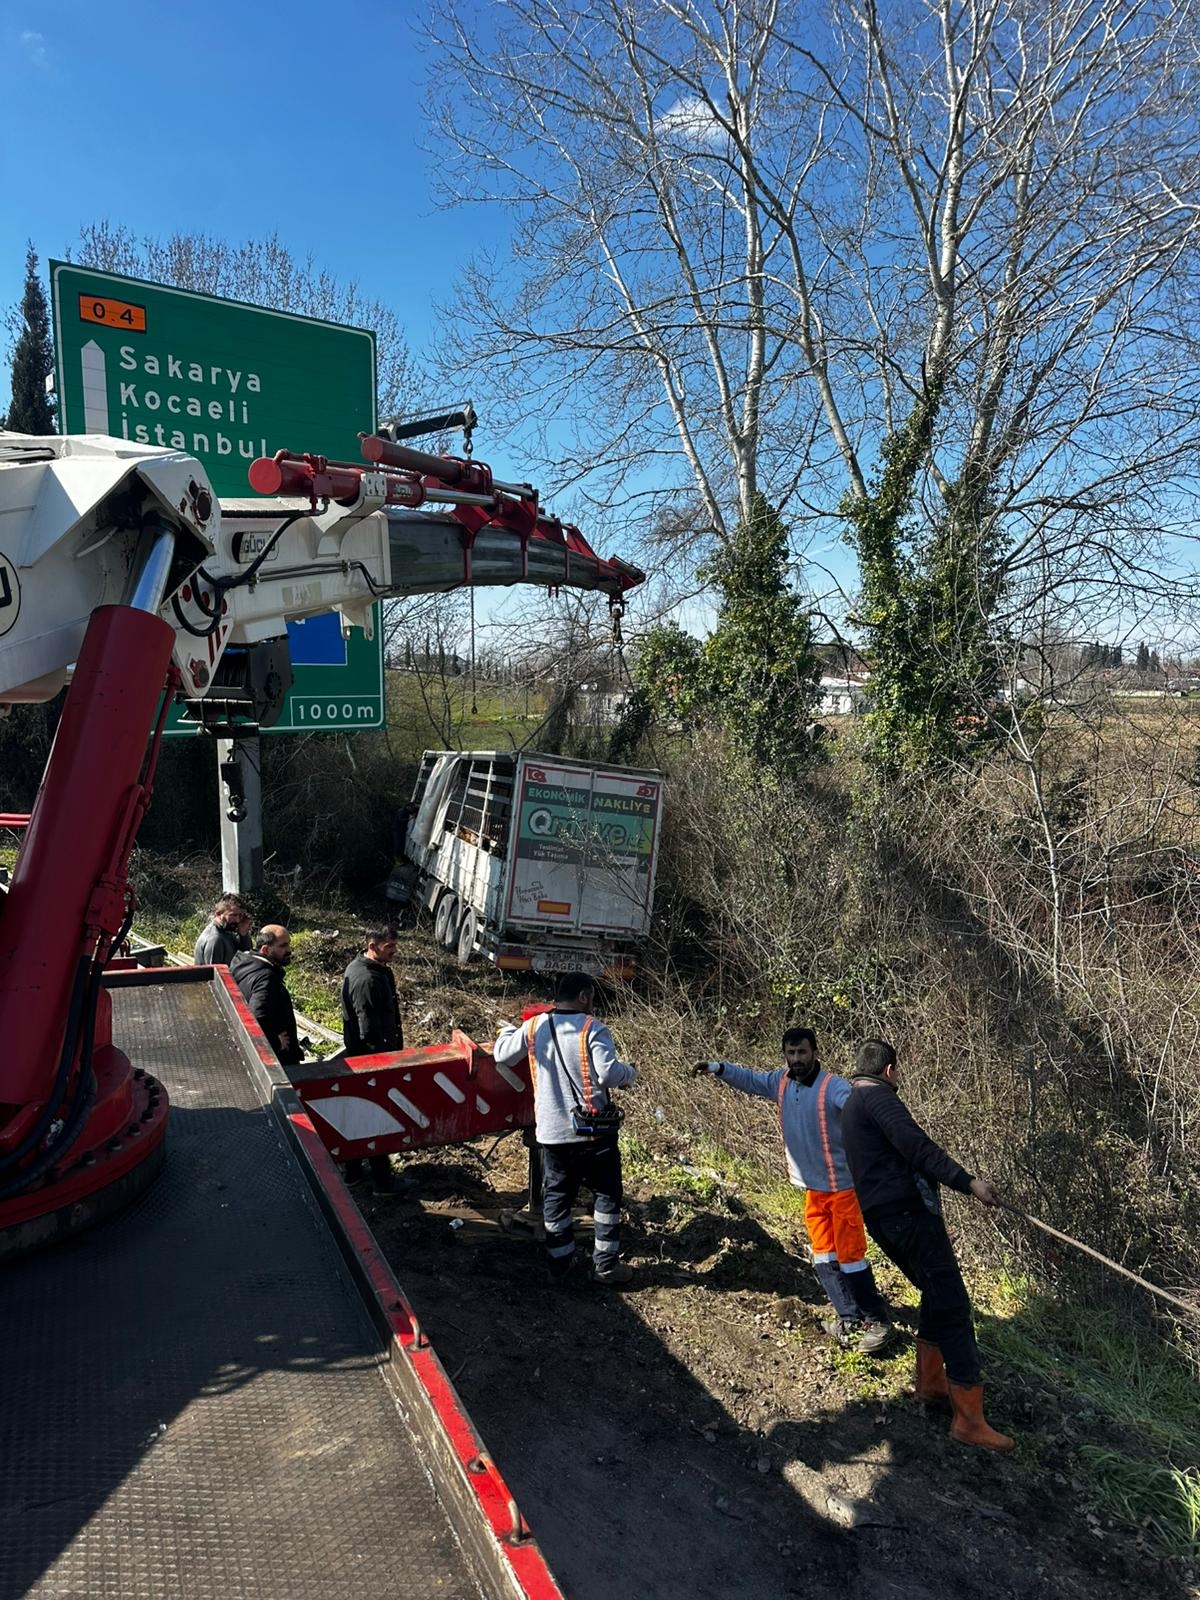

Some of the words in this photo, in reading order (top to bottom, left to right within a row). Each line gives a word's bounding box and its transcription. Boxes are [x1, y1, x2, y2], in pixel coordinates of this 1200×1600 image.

[119, 345, 261, 393] Sakarya
[119, 382, 249, 424] Kocaeli
[120, 411, 267, 459] İstanbul
[298, 703, 374, 720] 1000m
[593, 796, 652, 814] NAKLİYE
